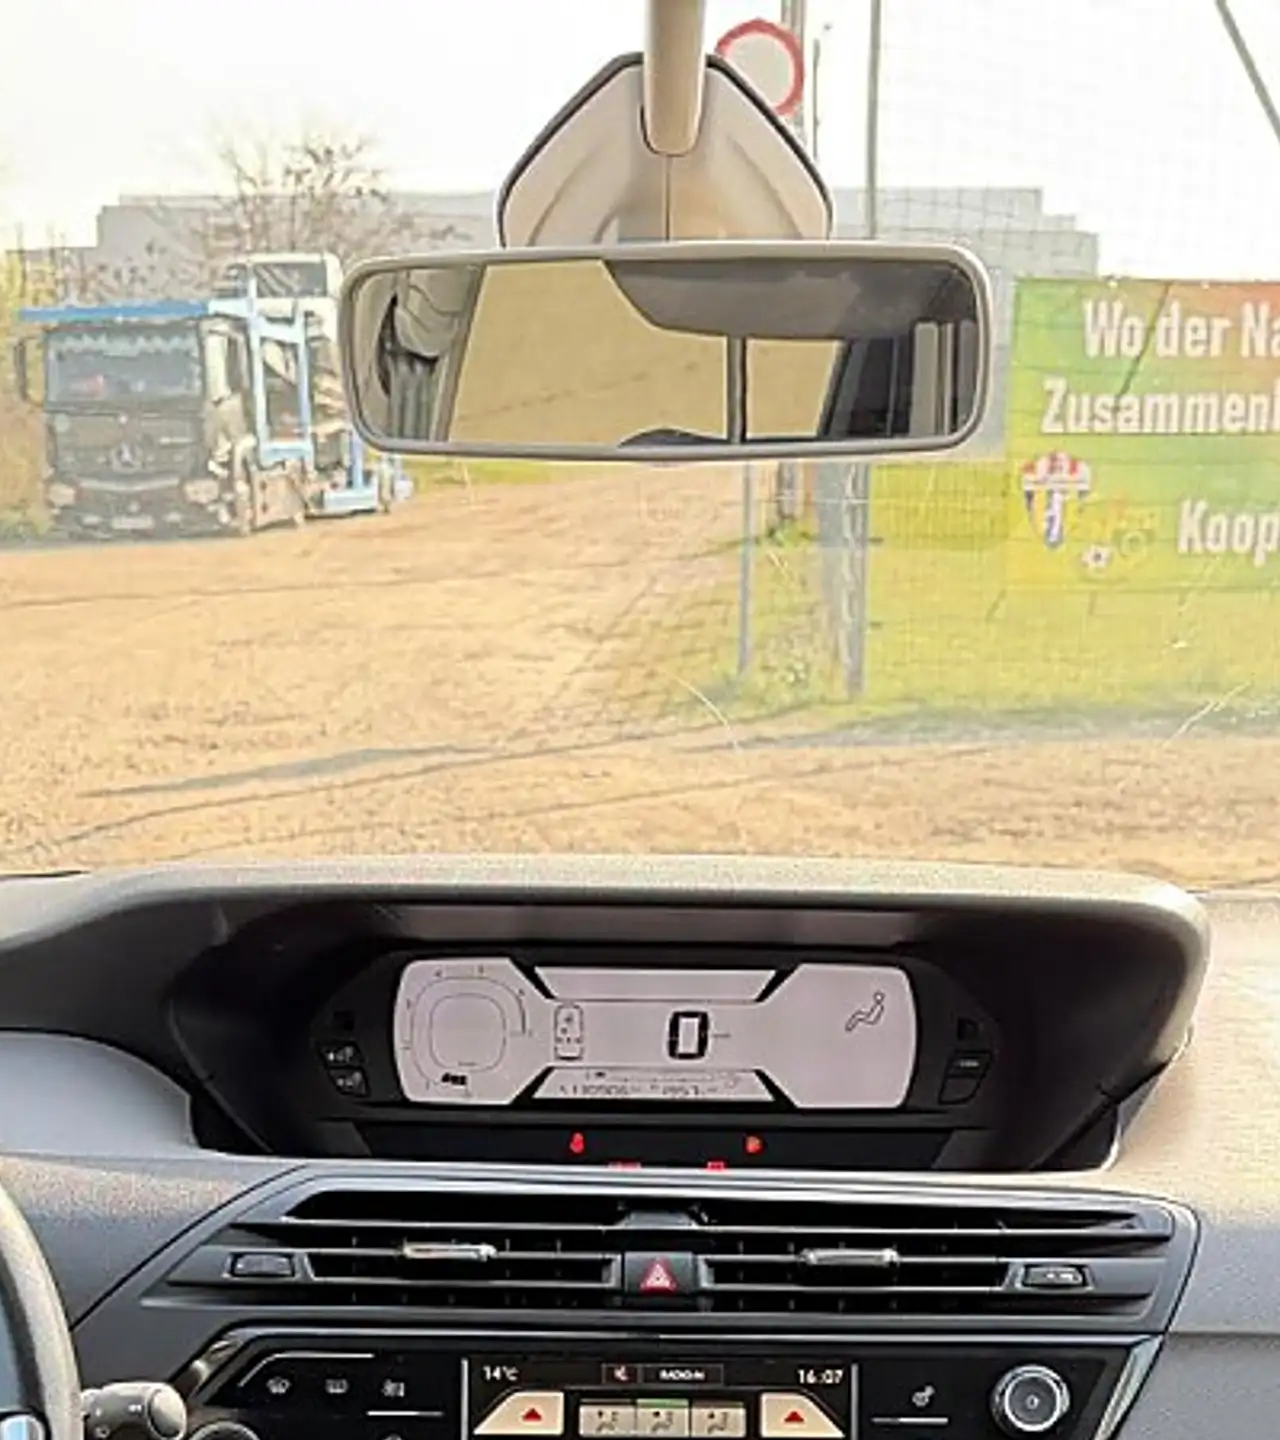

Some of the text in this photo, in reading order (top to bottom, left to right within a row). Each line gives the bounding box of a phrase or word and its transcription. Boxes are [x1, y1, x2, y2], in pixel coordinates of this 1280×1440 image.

[1083, 298, 1144, 359] Wo
[1155, 302, 1233, 358] der
[668, 1010, 709, 1060] 0
[798, 1369, 844, 1385] 16:07
